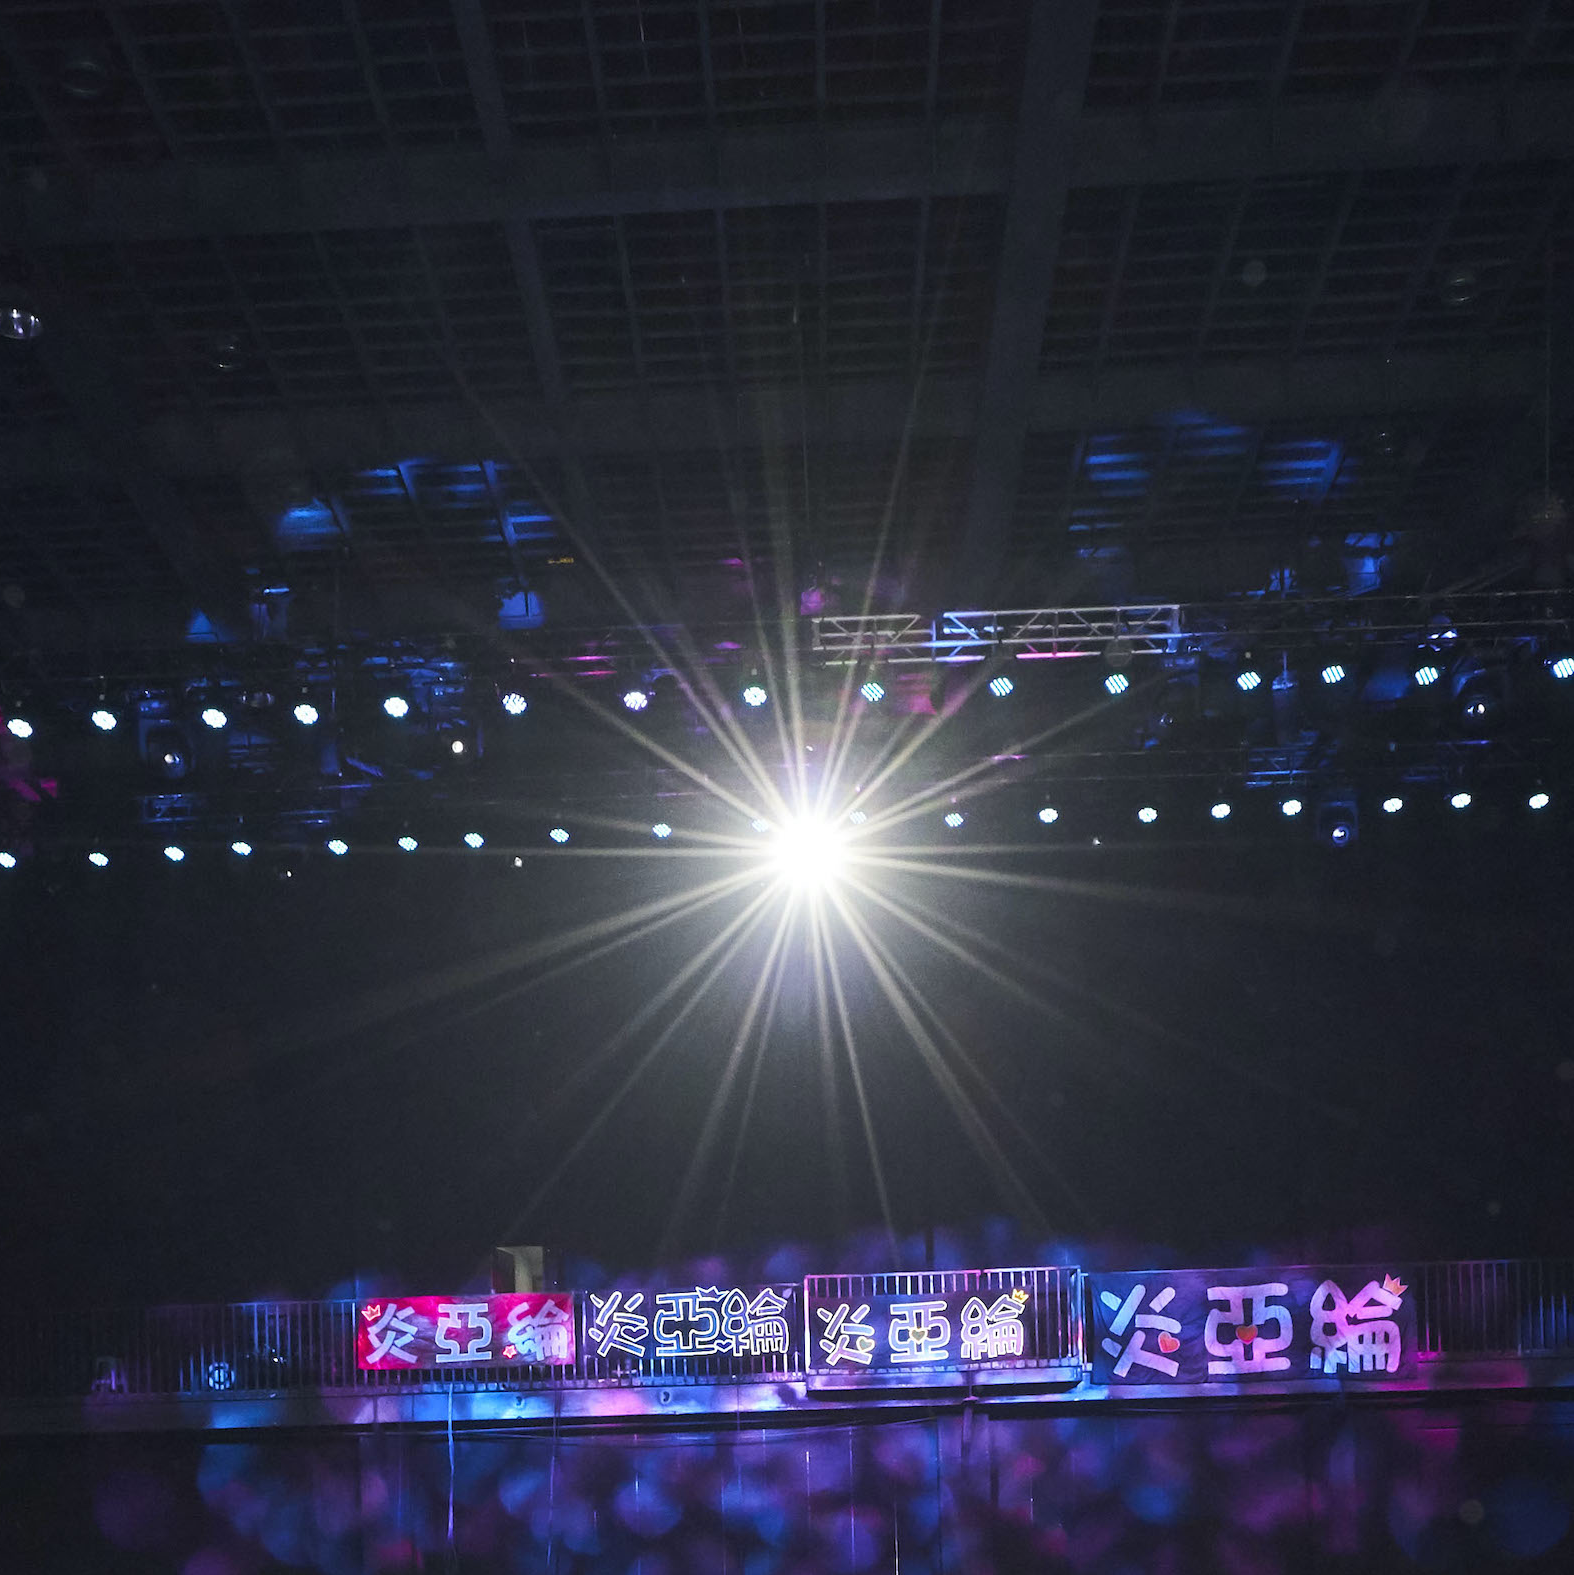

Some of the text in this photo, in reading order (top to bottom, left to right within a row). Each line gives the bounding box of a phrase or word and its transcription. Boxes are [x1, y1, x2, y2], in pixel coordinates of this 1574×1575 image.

[588, 1288, 790, 1358] 炎亞綸
[817, 1294, 1026, 1366] 炎亞綸
[1100, 1279, 1403, 1378] 炎亞綸
